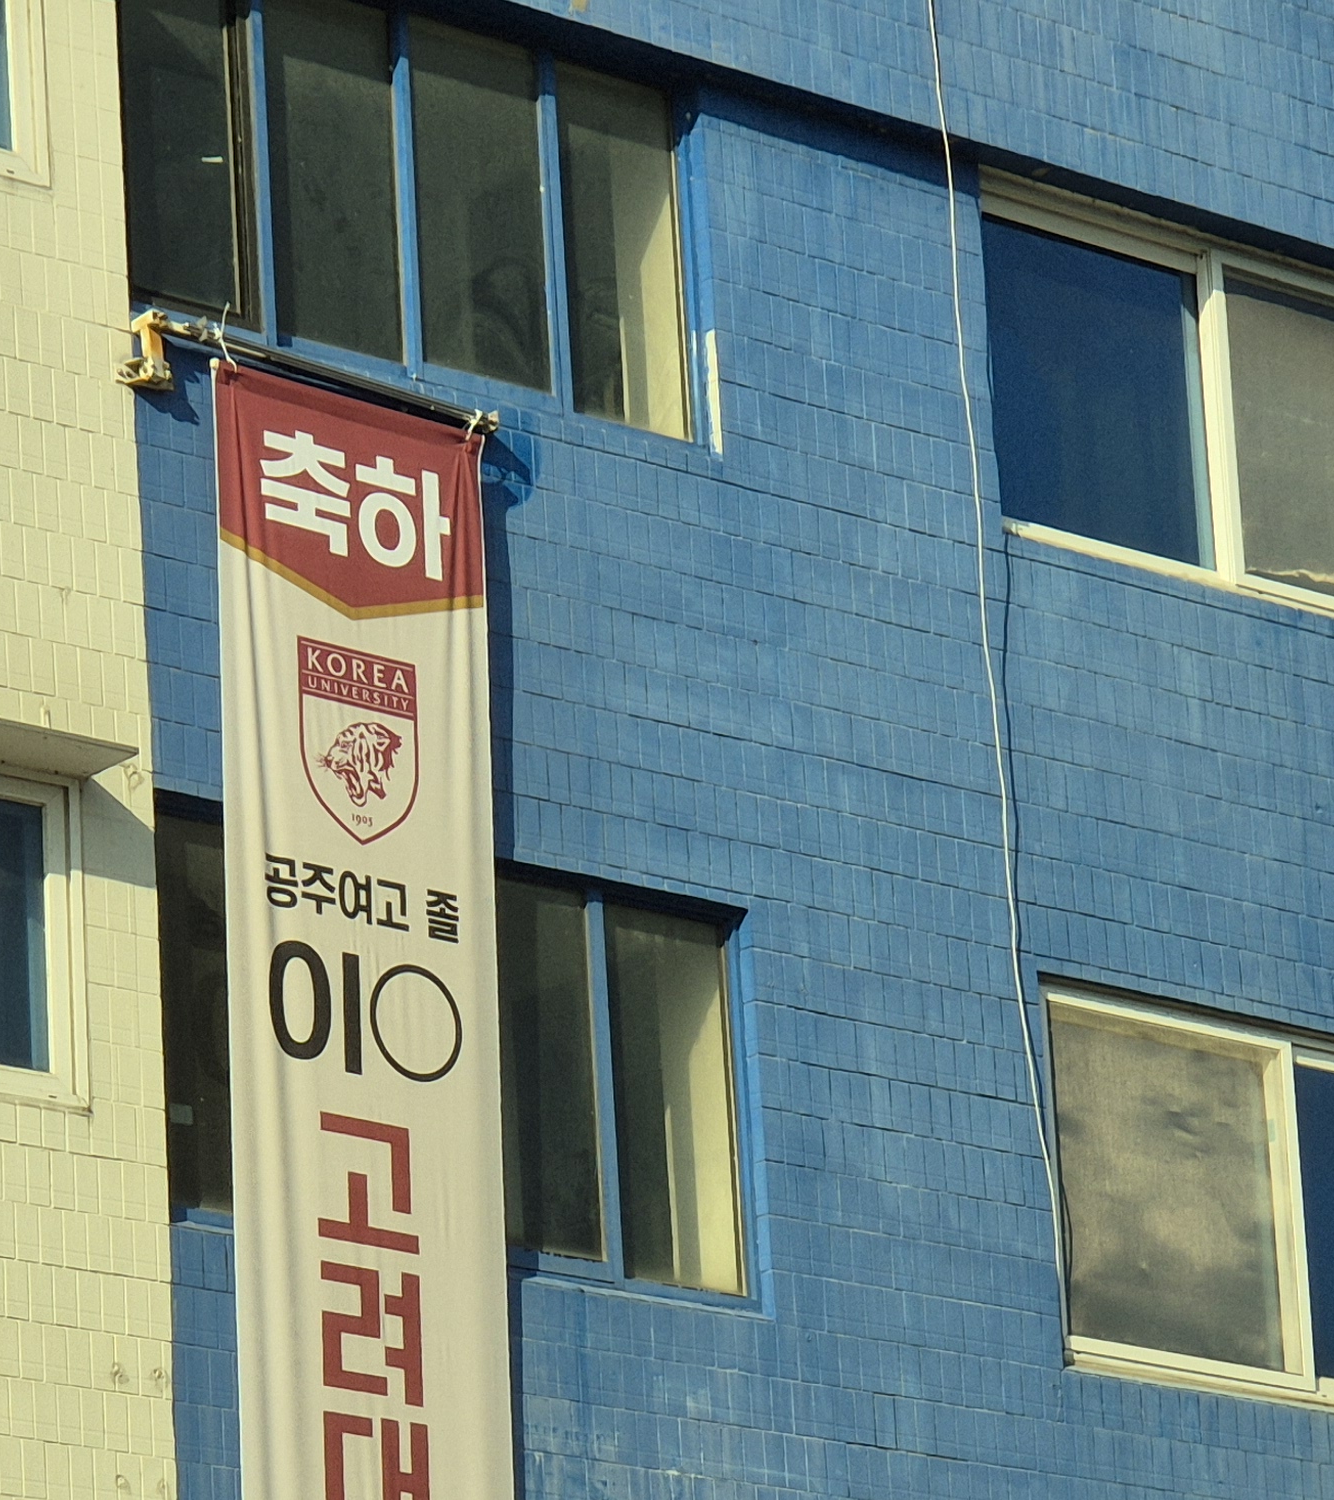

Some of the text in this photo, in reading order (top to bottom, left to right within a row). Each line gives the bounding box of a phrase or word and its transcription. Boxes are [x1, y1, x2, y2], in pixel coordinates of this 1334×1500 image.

[259, 429, 452, 582] 축하
[307, 646, 409, 693] KOREA
[307, 675, 409, 711] UNIVERSITY
[351, 813, 373, 827] 1905
[264, 852, 459, 944] 공주여고 졸
